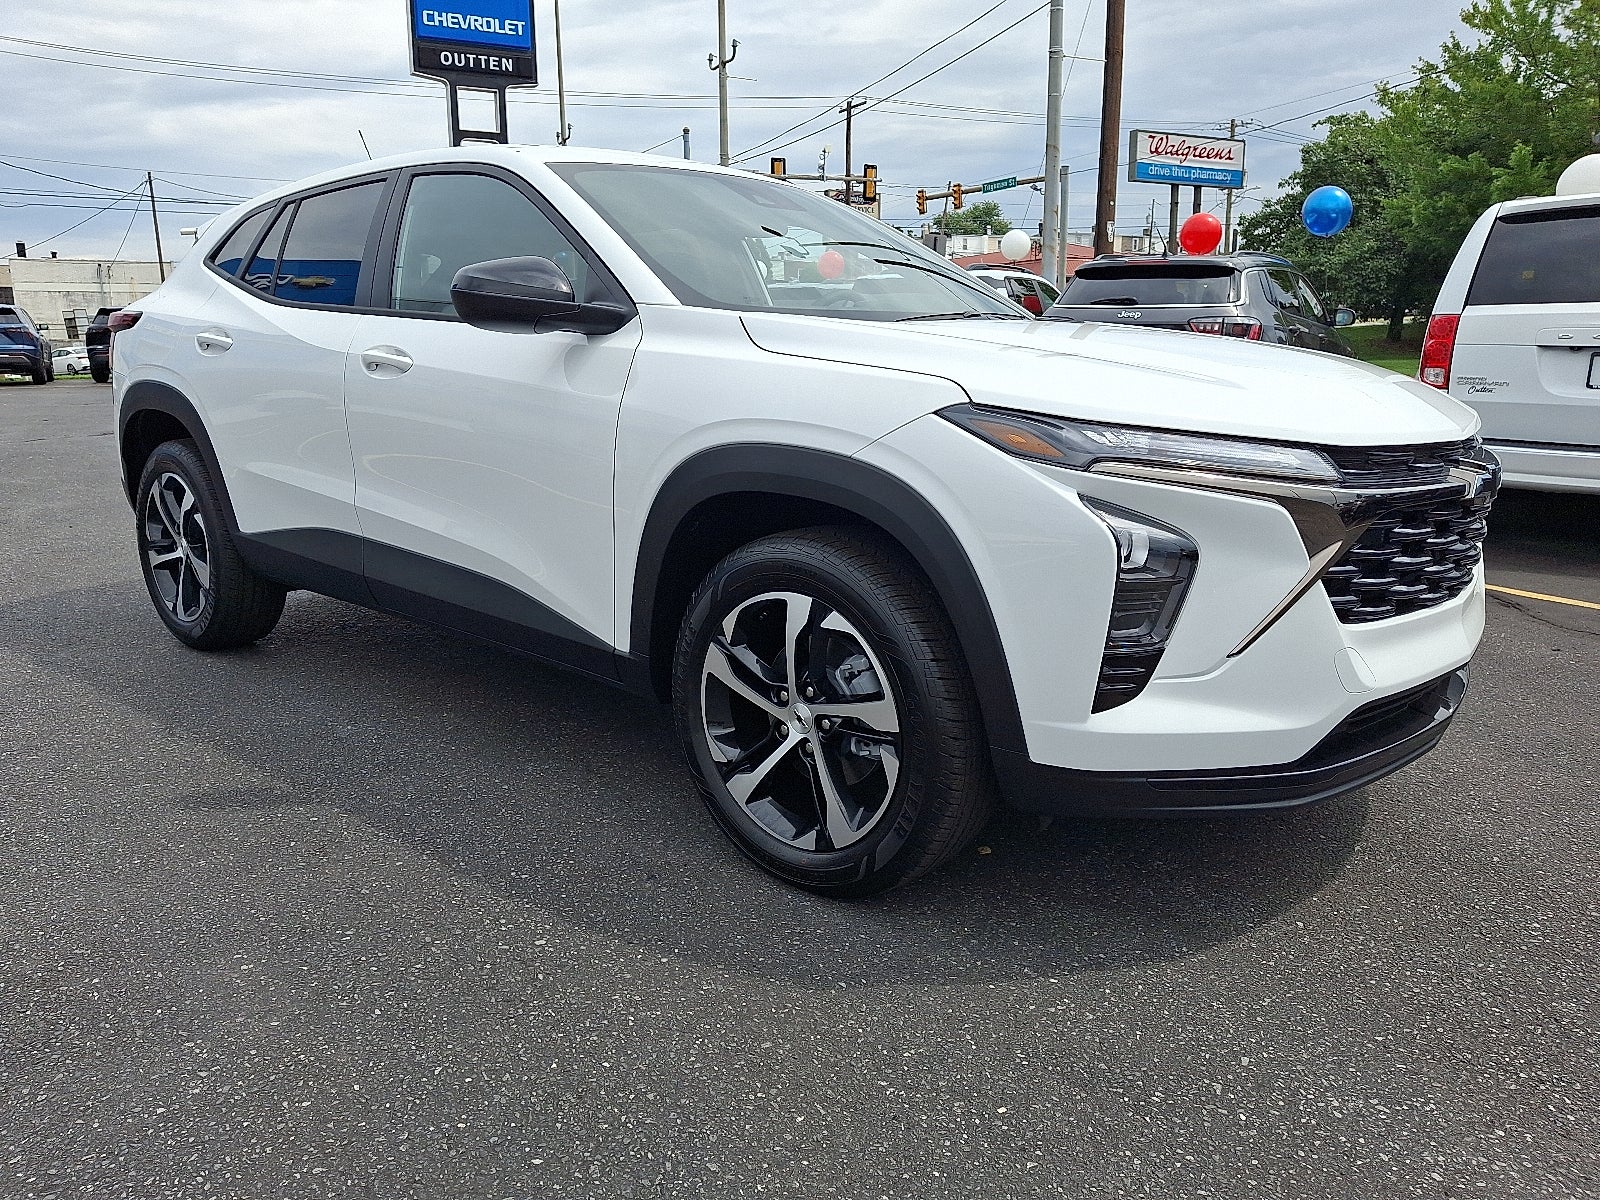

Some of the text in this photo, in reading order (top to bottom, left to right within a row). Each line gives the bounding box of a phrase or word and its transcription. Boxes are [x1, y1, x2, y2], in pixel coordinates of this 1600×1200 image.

[422, 9, 526, 35] CHEVROLET
[440, 51, 513, 72] OUTTEN
[1148, 134, 1234, 164] Walgreens
[1148, 164, 1232, 183] drive thru pharmacy
[1117, 310, 1142, 320] Jeep
